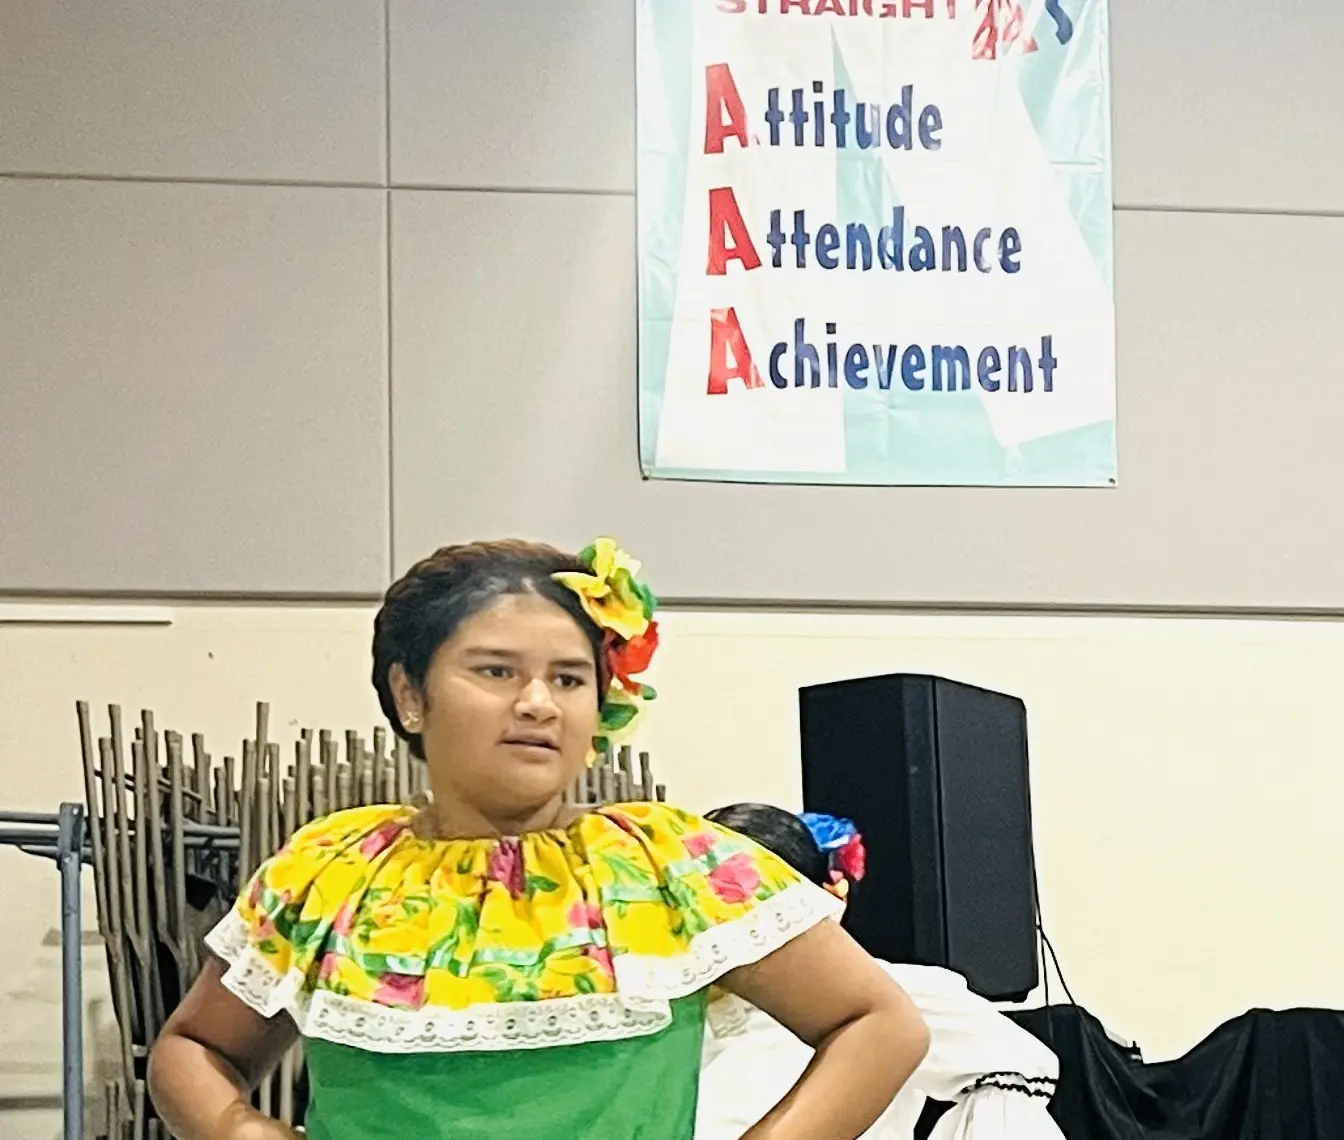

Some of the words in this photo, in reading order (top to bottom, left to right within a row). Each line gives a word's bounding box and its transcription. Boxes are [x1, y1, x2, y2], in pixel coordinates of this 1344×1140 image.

[704, 62, 943, 155] Attitude
[705, 186, 1022, 276] Attendance
[706, 306, 1058, 396] Achievement
